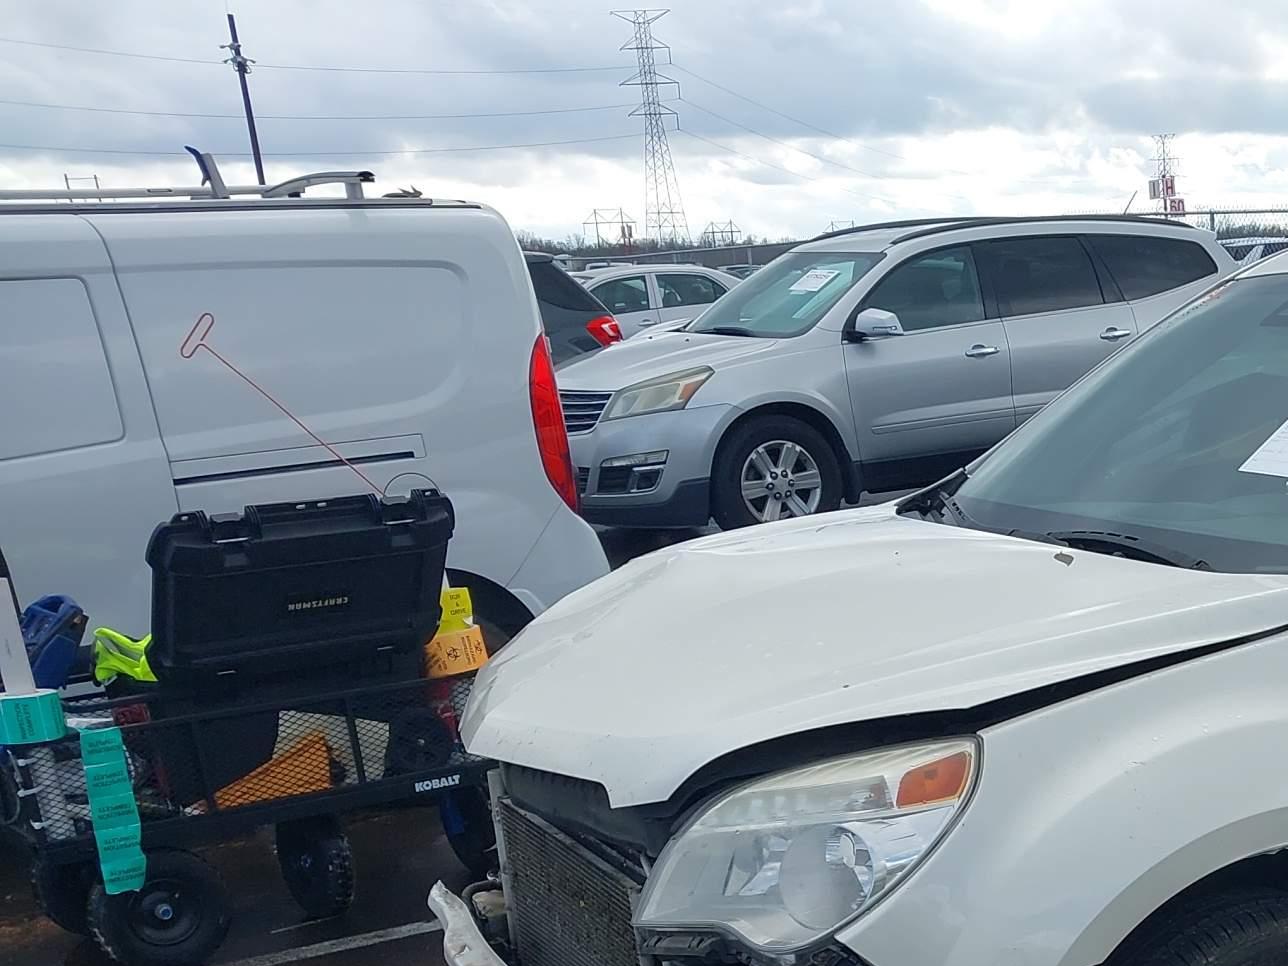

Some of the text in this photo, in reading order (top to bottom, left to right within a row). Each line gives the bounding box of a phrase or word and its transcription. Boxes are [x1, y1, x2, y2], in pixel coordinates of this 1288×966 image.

[1165, 178, 1174, 196] H
[288, 597, 349, 611] CRAFTSMAN
[415, 775, 460, 792] KOBALT
